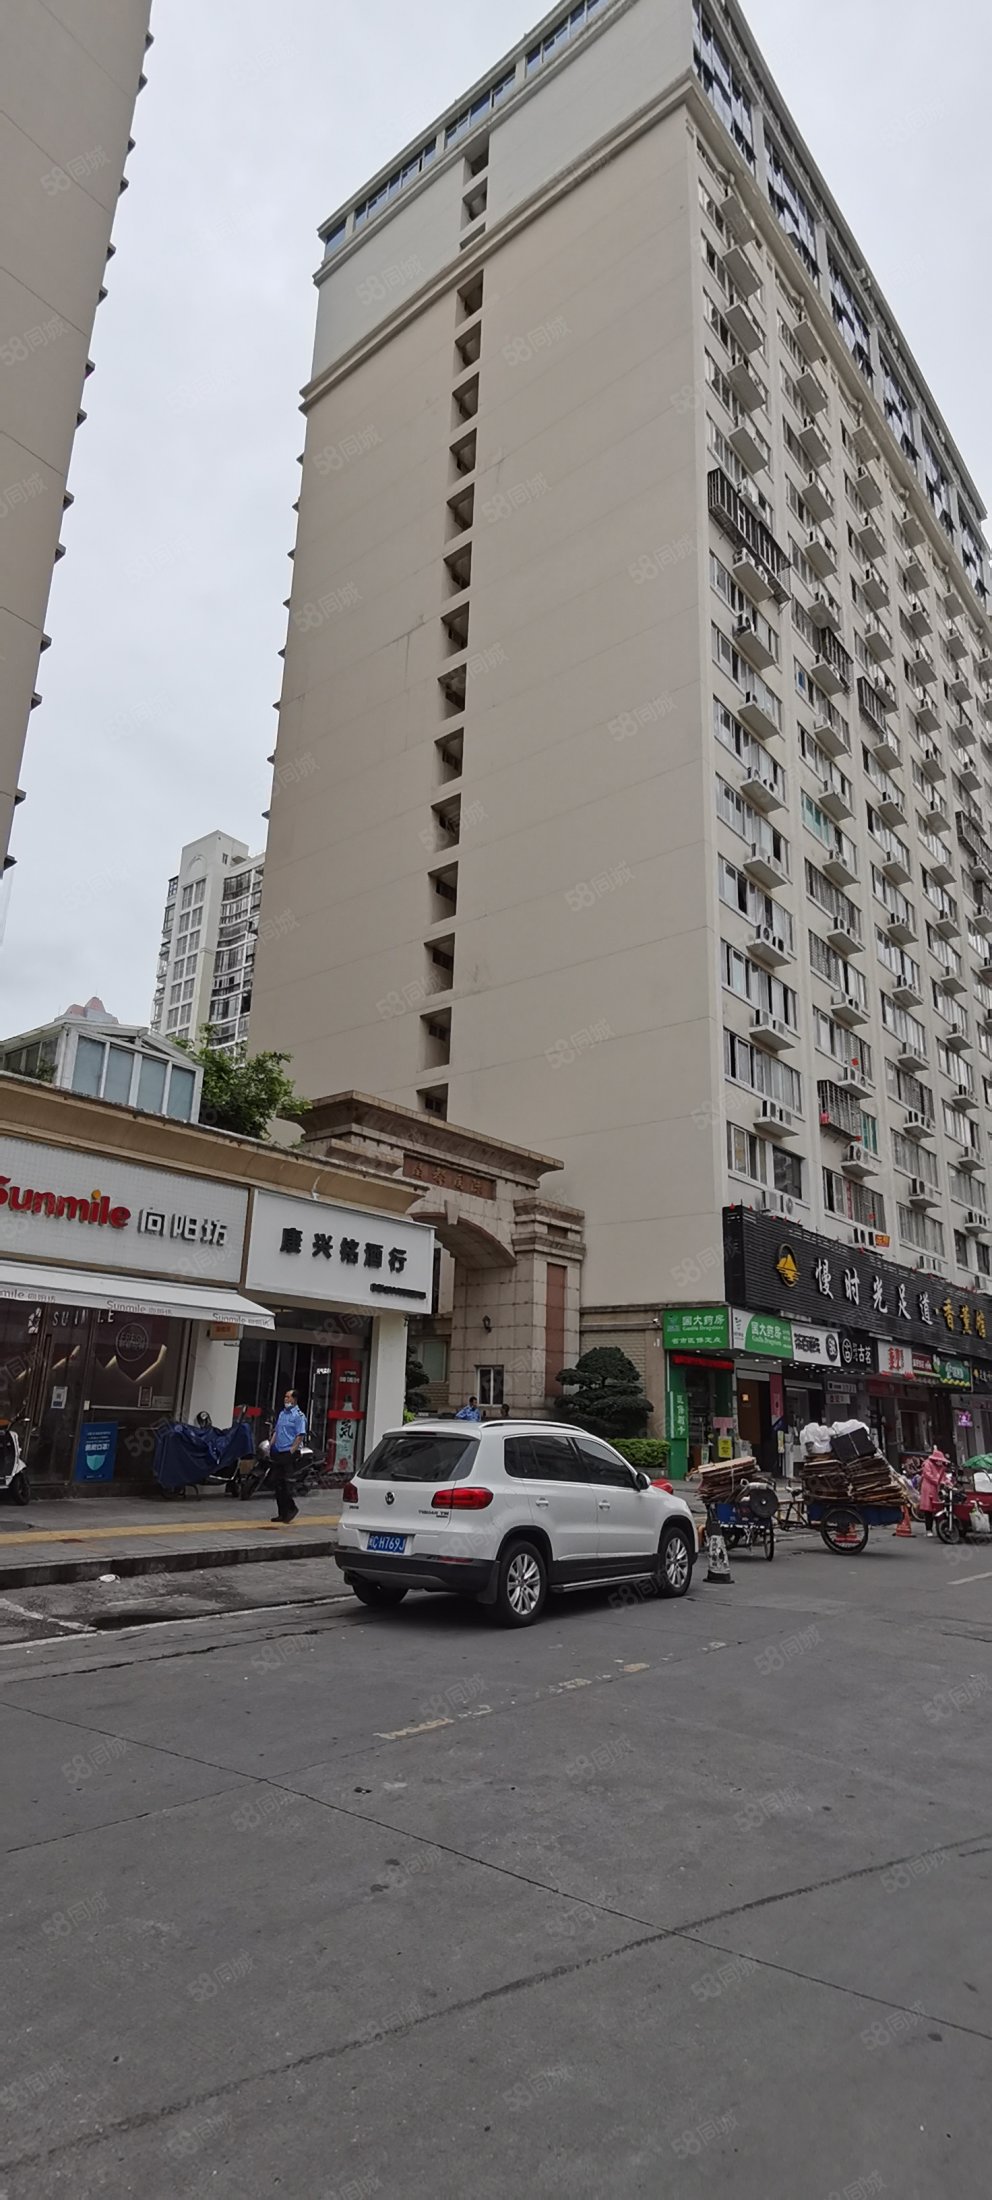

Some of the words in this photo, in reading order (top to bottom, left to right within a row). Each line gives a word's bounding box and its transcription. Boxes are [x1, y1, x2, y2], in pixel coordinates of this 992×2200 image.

[137, 1207, 228, 1247] 向阳坊
[280, 1227, 408, 1274] 康兴铭酒行
